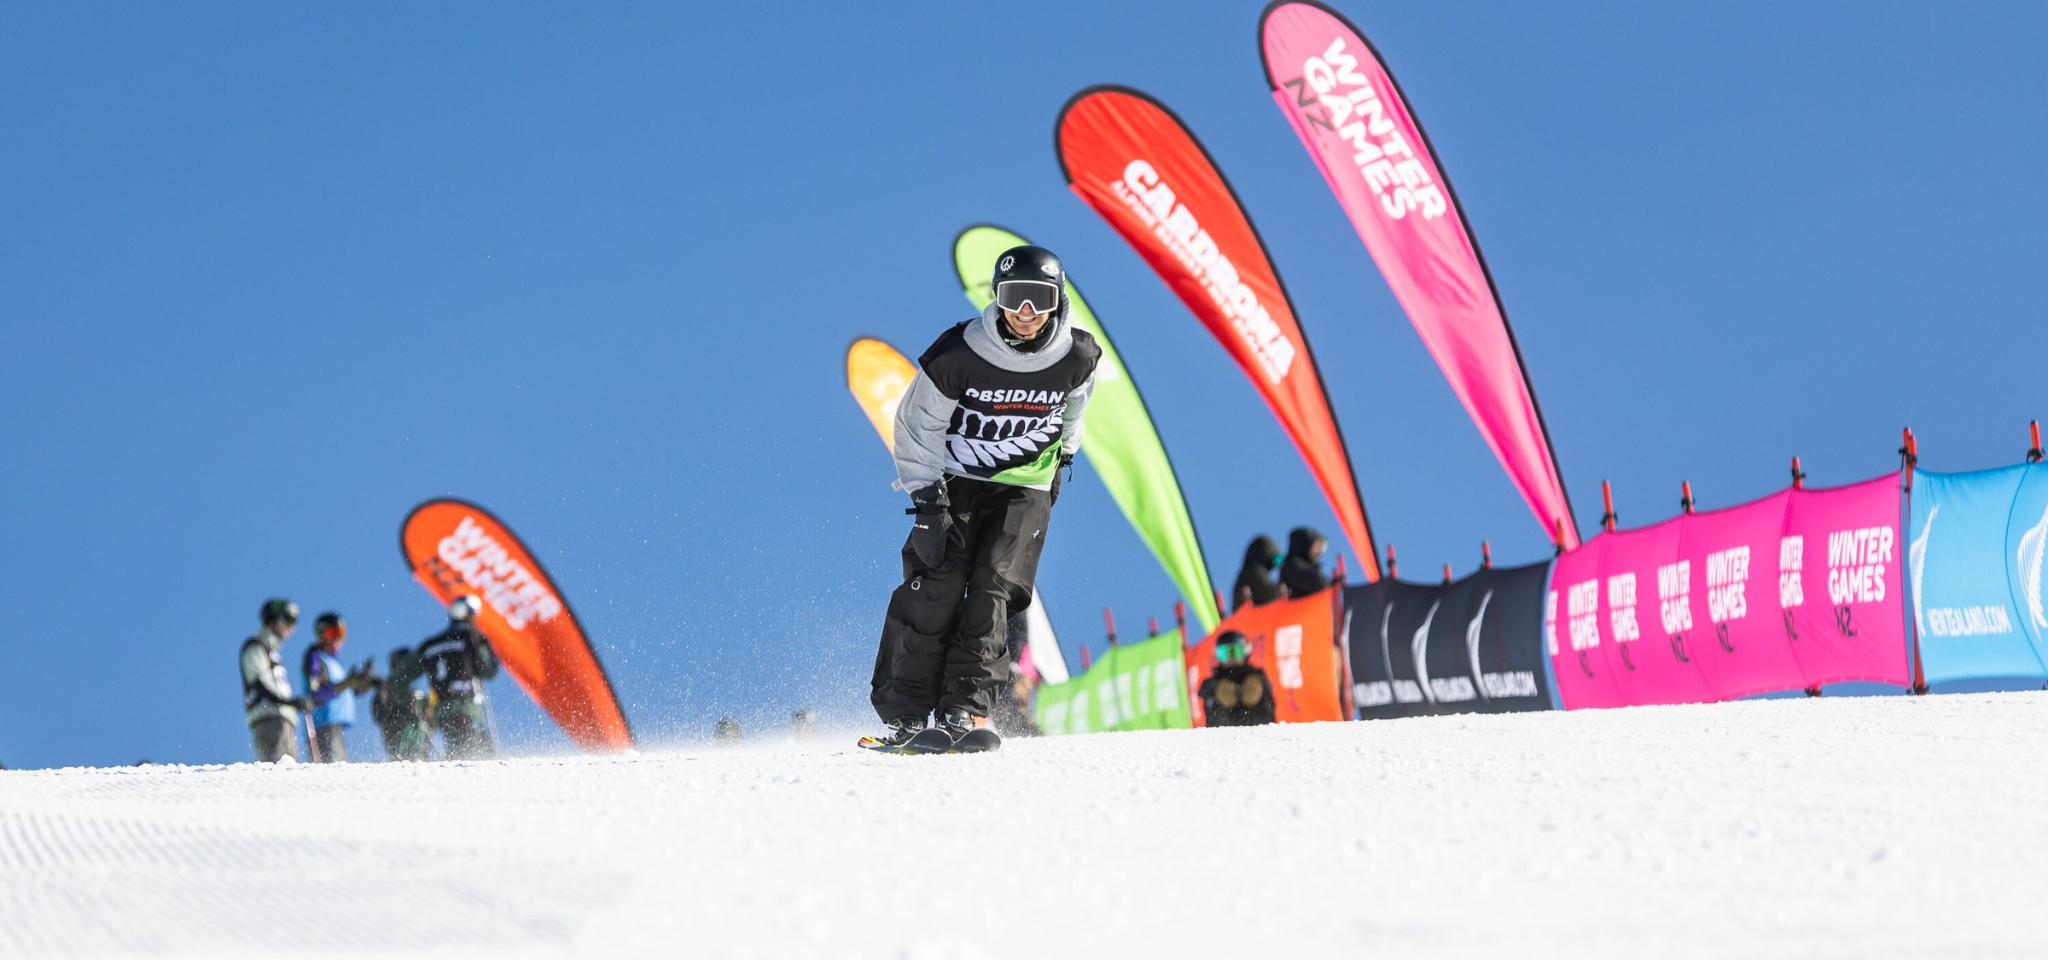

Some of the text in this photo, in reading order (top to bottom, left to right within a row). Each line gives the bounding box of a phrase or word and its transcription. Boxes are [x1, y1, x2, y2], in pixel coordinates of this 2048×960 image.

[1303, 56, 1416, 219] GAMES
[1324, 36, 1446, 221] WINTER
[1123, 159, 1295, 378] CARDRONA
[965, 388, 1065, 404] OBSIDIAN
[1707, 545, 1750, 588] WINTER
[1780, 535, 1804, 571] WINTER
[1828, 525, 1894, 568] WINTER
[437, 536, 529, 631] GAMES
[453, 516, 561, 624] WINTER
[1608, 571, 1637, 609] WINTER
[1657, 559, 1691, 601] WINTER
[1779, 572, 1804, 609] GAMES
[1828, 564, 1886, 606] GAMES
[1568, 578, 1599, 618] WINTER
[1660, 595, 1693, 635] GAMES
[1708, 582, 1747, 624] GAMES
[1568, 612, 1601, 652] GAMES
[1610, 606, 1640, 643] GAMES
